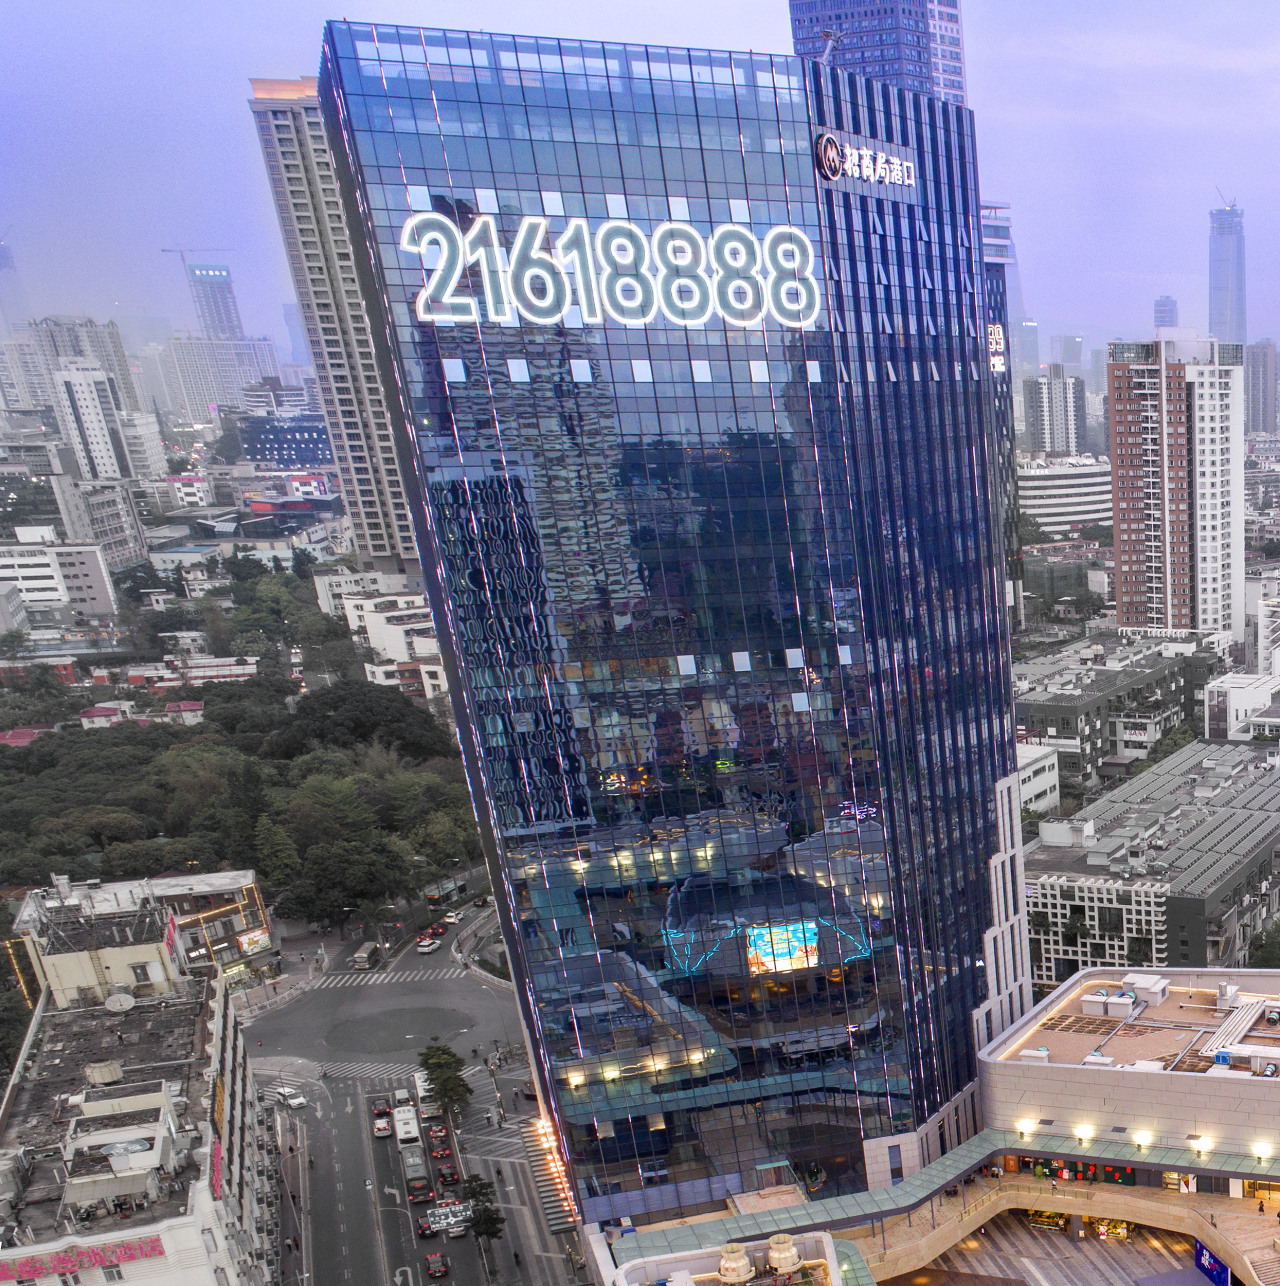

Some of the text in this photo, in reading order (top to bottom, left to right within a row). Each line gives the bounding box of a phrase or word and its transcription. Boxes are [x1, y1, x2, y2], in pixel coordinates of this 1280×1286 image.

[843, 143, 915, 187] 招商局港口
[400, 212, 821, 327] 21618888
